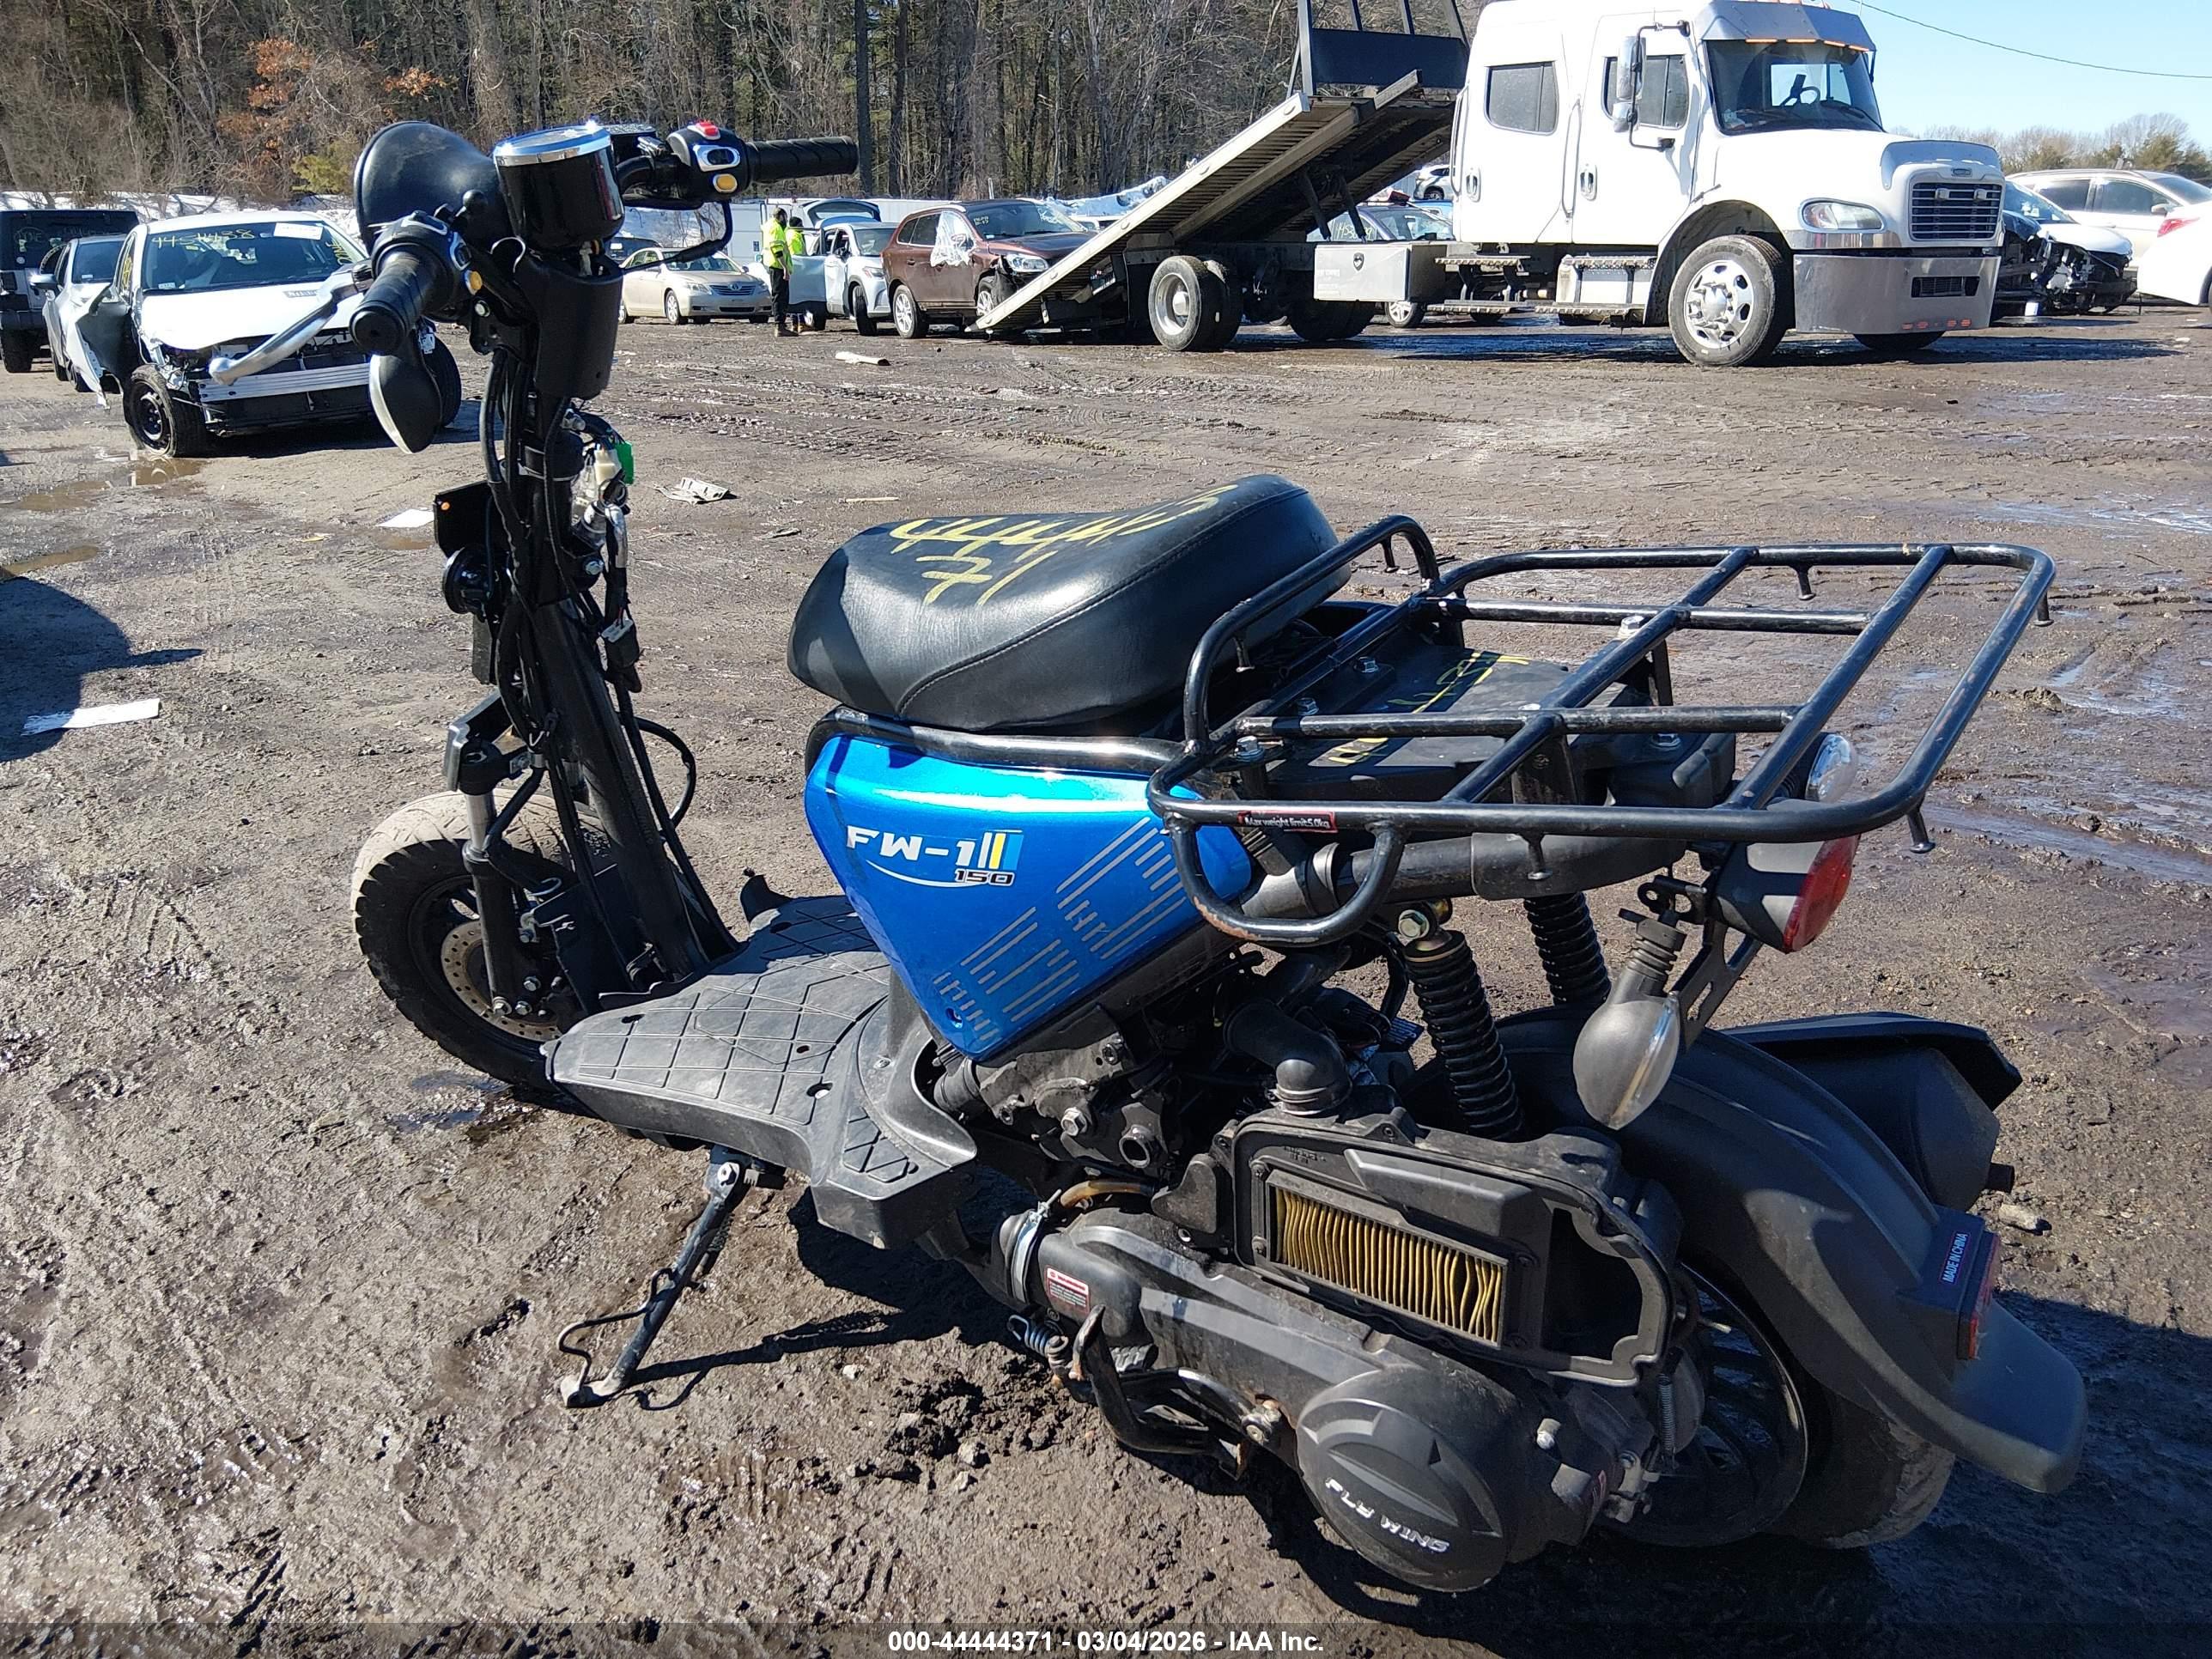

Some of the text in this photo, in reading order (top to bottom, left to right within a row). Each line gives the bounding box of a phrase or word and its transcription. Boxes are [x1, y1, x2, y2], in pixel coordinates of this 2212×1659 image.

[1262, 816, 1288, 828] weight
[954, 868, 1016, 887] 150
[1942, 1261, 1960, 1283] MADE
[1951, 1233, 1969, 1255] CHINA
[1380, 1514, 1450, 1553] WING
